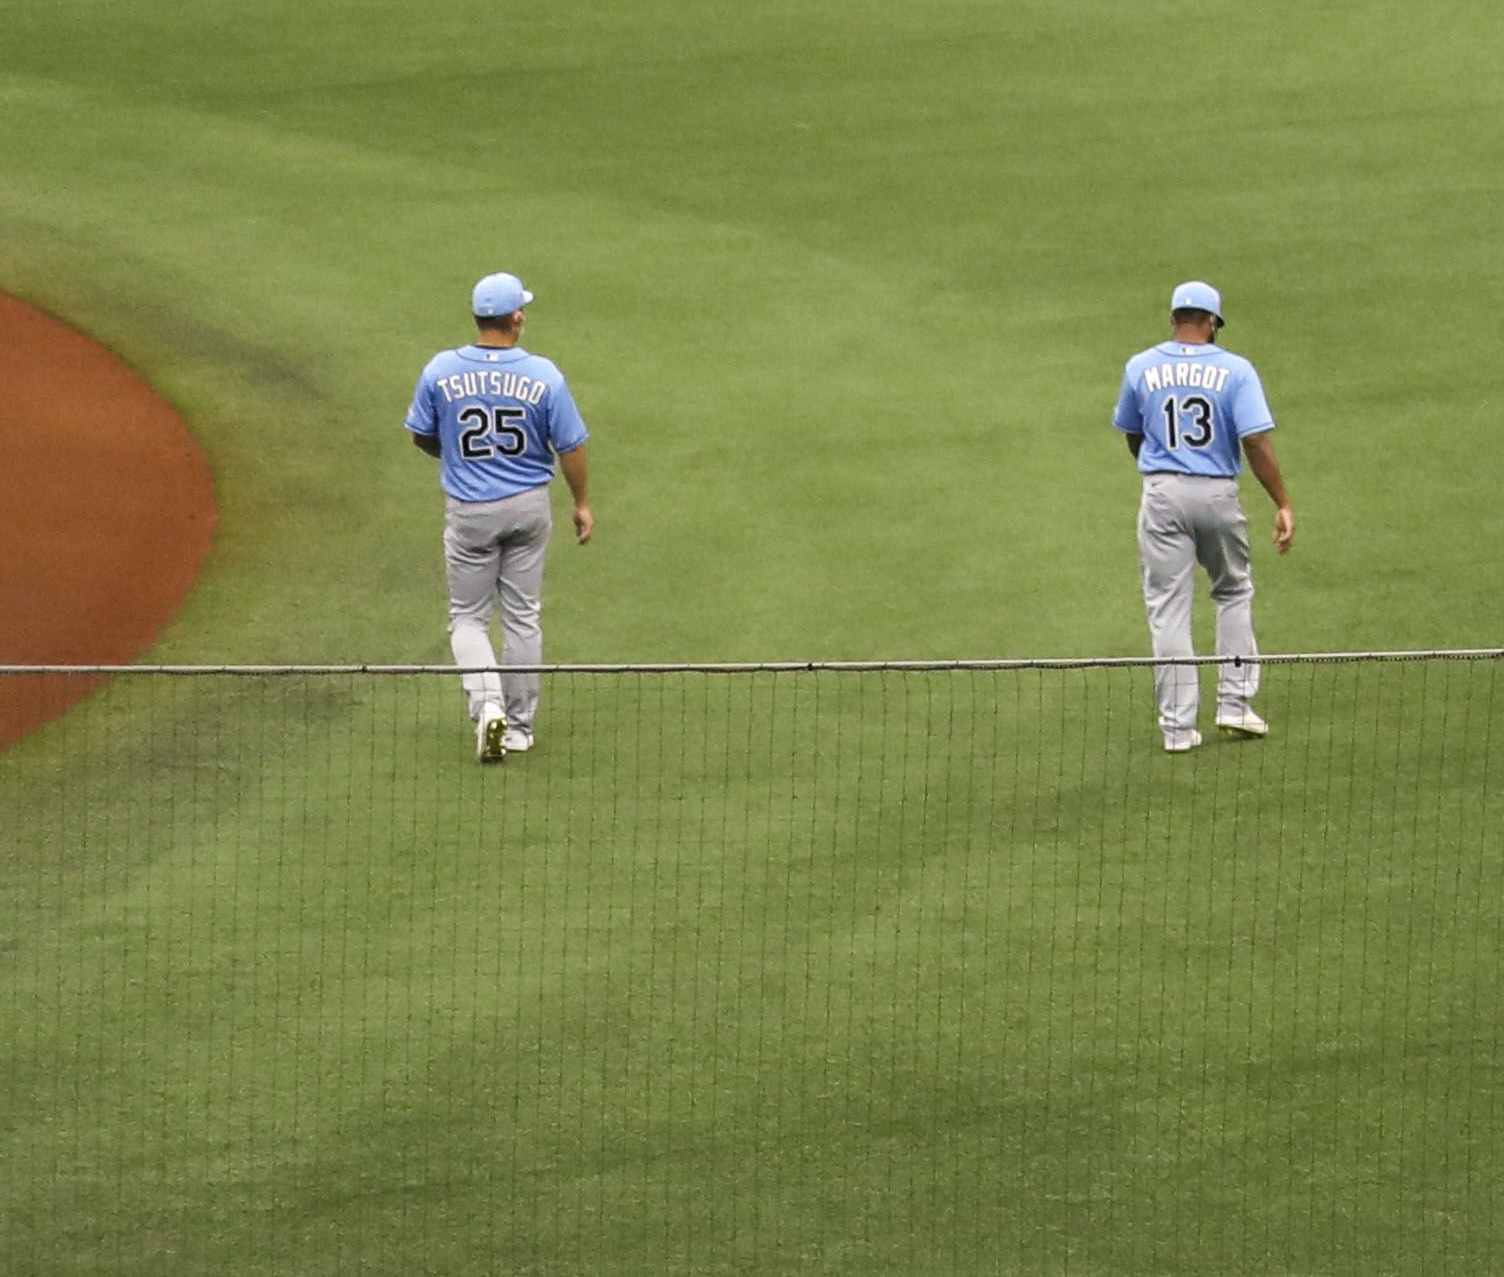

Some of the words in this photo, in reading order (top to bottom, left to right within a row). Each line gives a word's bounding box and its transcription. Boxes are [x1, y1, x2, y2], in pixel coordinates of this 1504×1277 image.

[437, 370, 547, 407] TSUTSUGO
[1143, 362, 1230, 393] MARGOT
[457, 405, 528, 460] 25
[1162, 394, 1215, 450] 13
